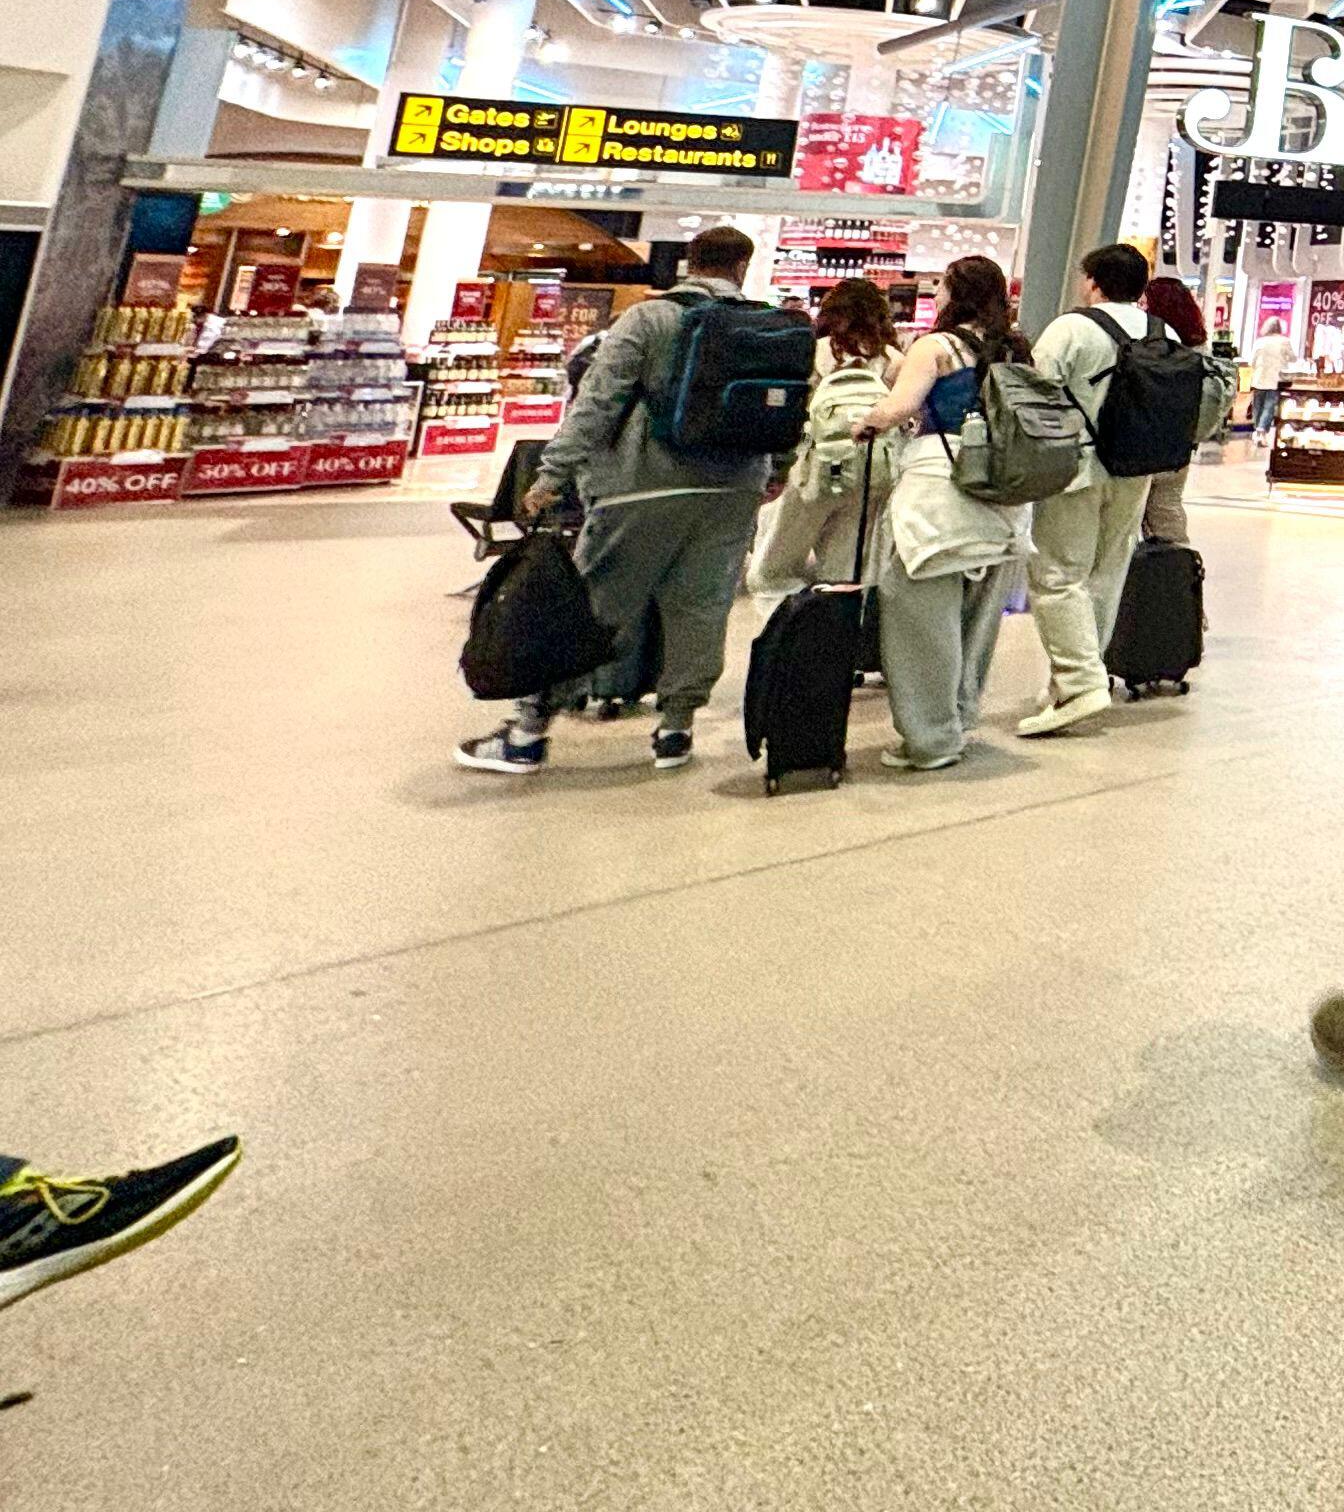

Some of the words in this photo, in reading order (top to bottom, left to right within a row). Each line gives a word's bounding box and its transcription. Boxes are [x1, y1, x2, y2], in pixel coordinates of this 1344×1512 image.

[446, 103, 530, 128] Gates
[607, 115, 718, 141] Lounges
[440, 130, 530, 157] Shops
[602, 141, 757, 168] Restaurants
[570, 307, 599, 322] FOR
[1310, 312, 1334, 326] OFF
[251, 460, 297, 476] OFF
[358, 454, 400, 470] OFF
[65, 476, 120, 494] 40%
[124, 473, 179, 491] OFF
